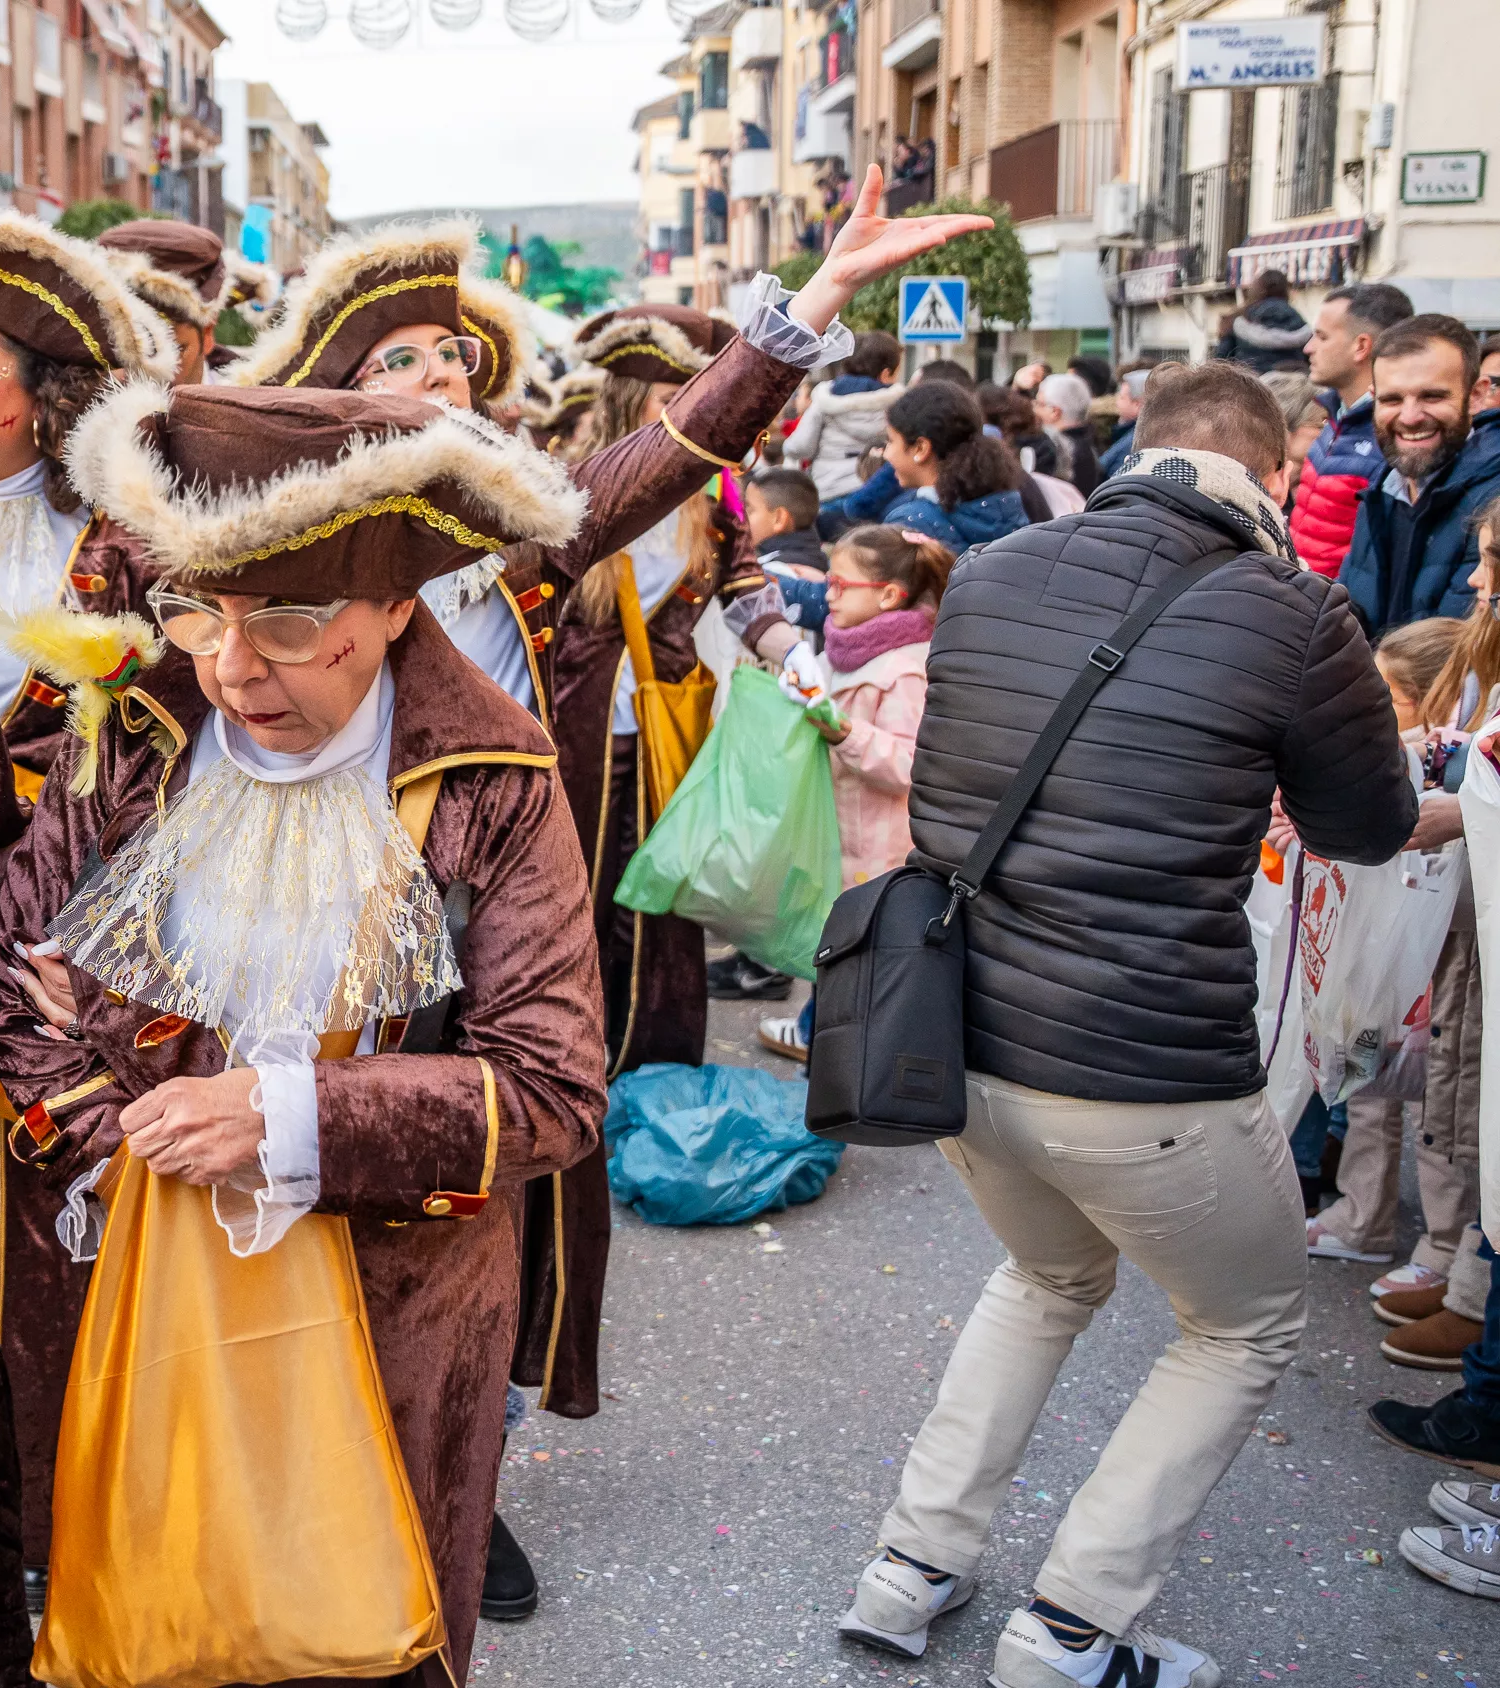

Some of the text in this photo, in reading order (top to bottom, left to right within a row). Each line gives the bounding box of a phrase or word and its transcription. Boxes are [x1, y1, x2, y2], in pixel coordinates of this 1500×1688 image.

[1414, 184, 1469, 196] VIANA
[873, 1571, 917, 1602] new balance
